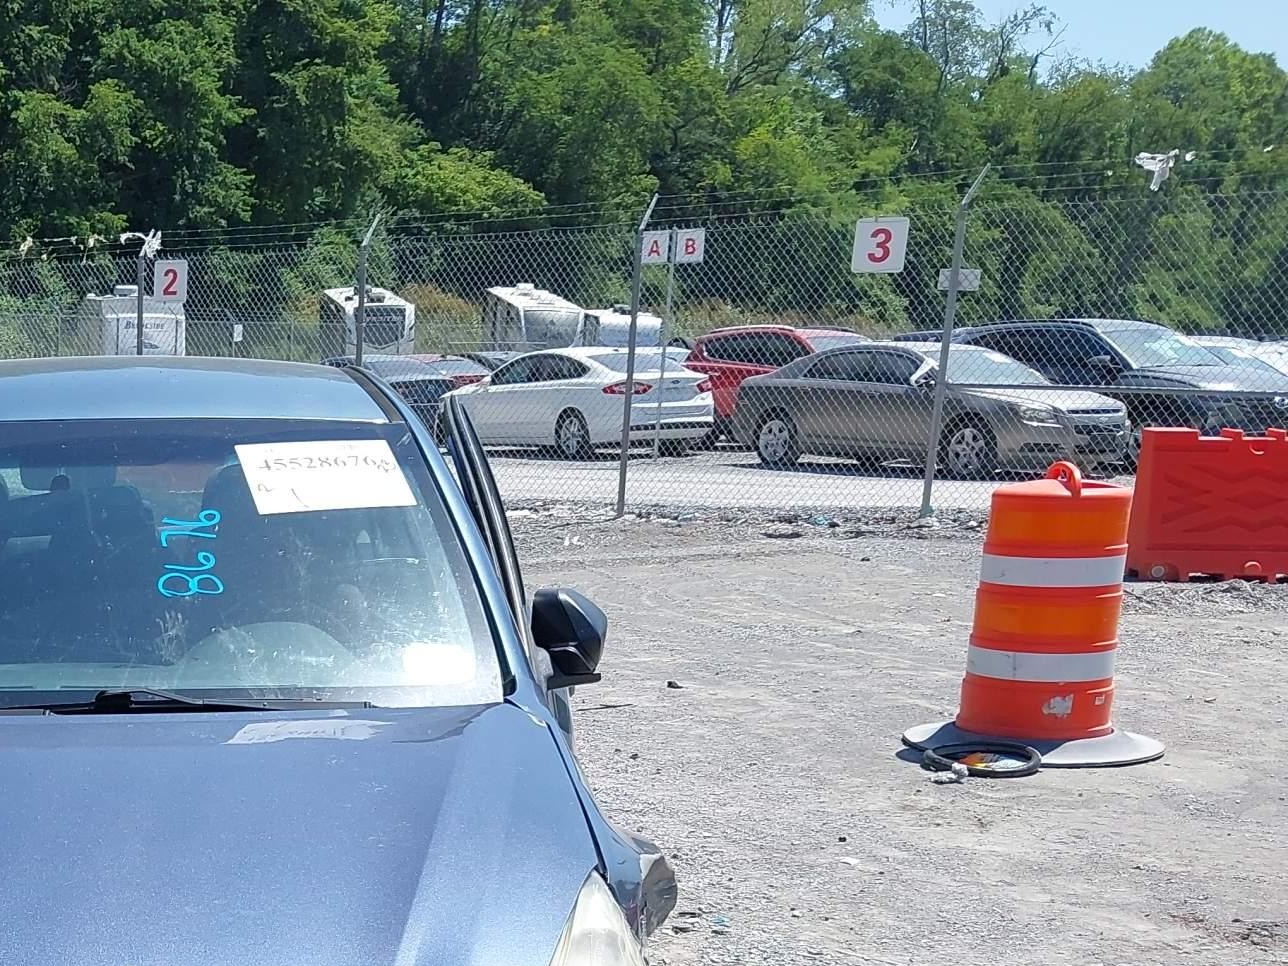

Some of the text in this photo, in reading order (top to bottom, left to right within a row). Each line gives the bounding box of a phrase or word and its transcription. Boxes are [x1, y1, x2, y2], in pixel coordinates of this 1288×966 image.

[647, 239, 661, 257] A
[684, 237, 697, 256] B
[867, 227, 893, 264] 3
[162, 267, 179, 297] 2
[157, 509, 224, 598] 8676
